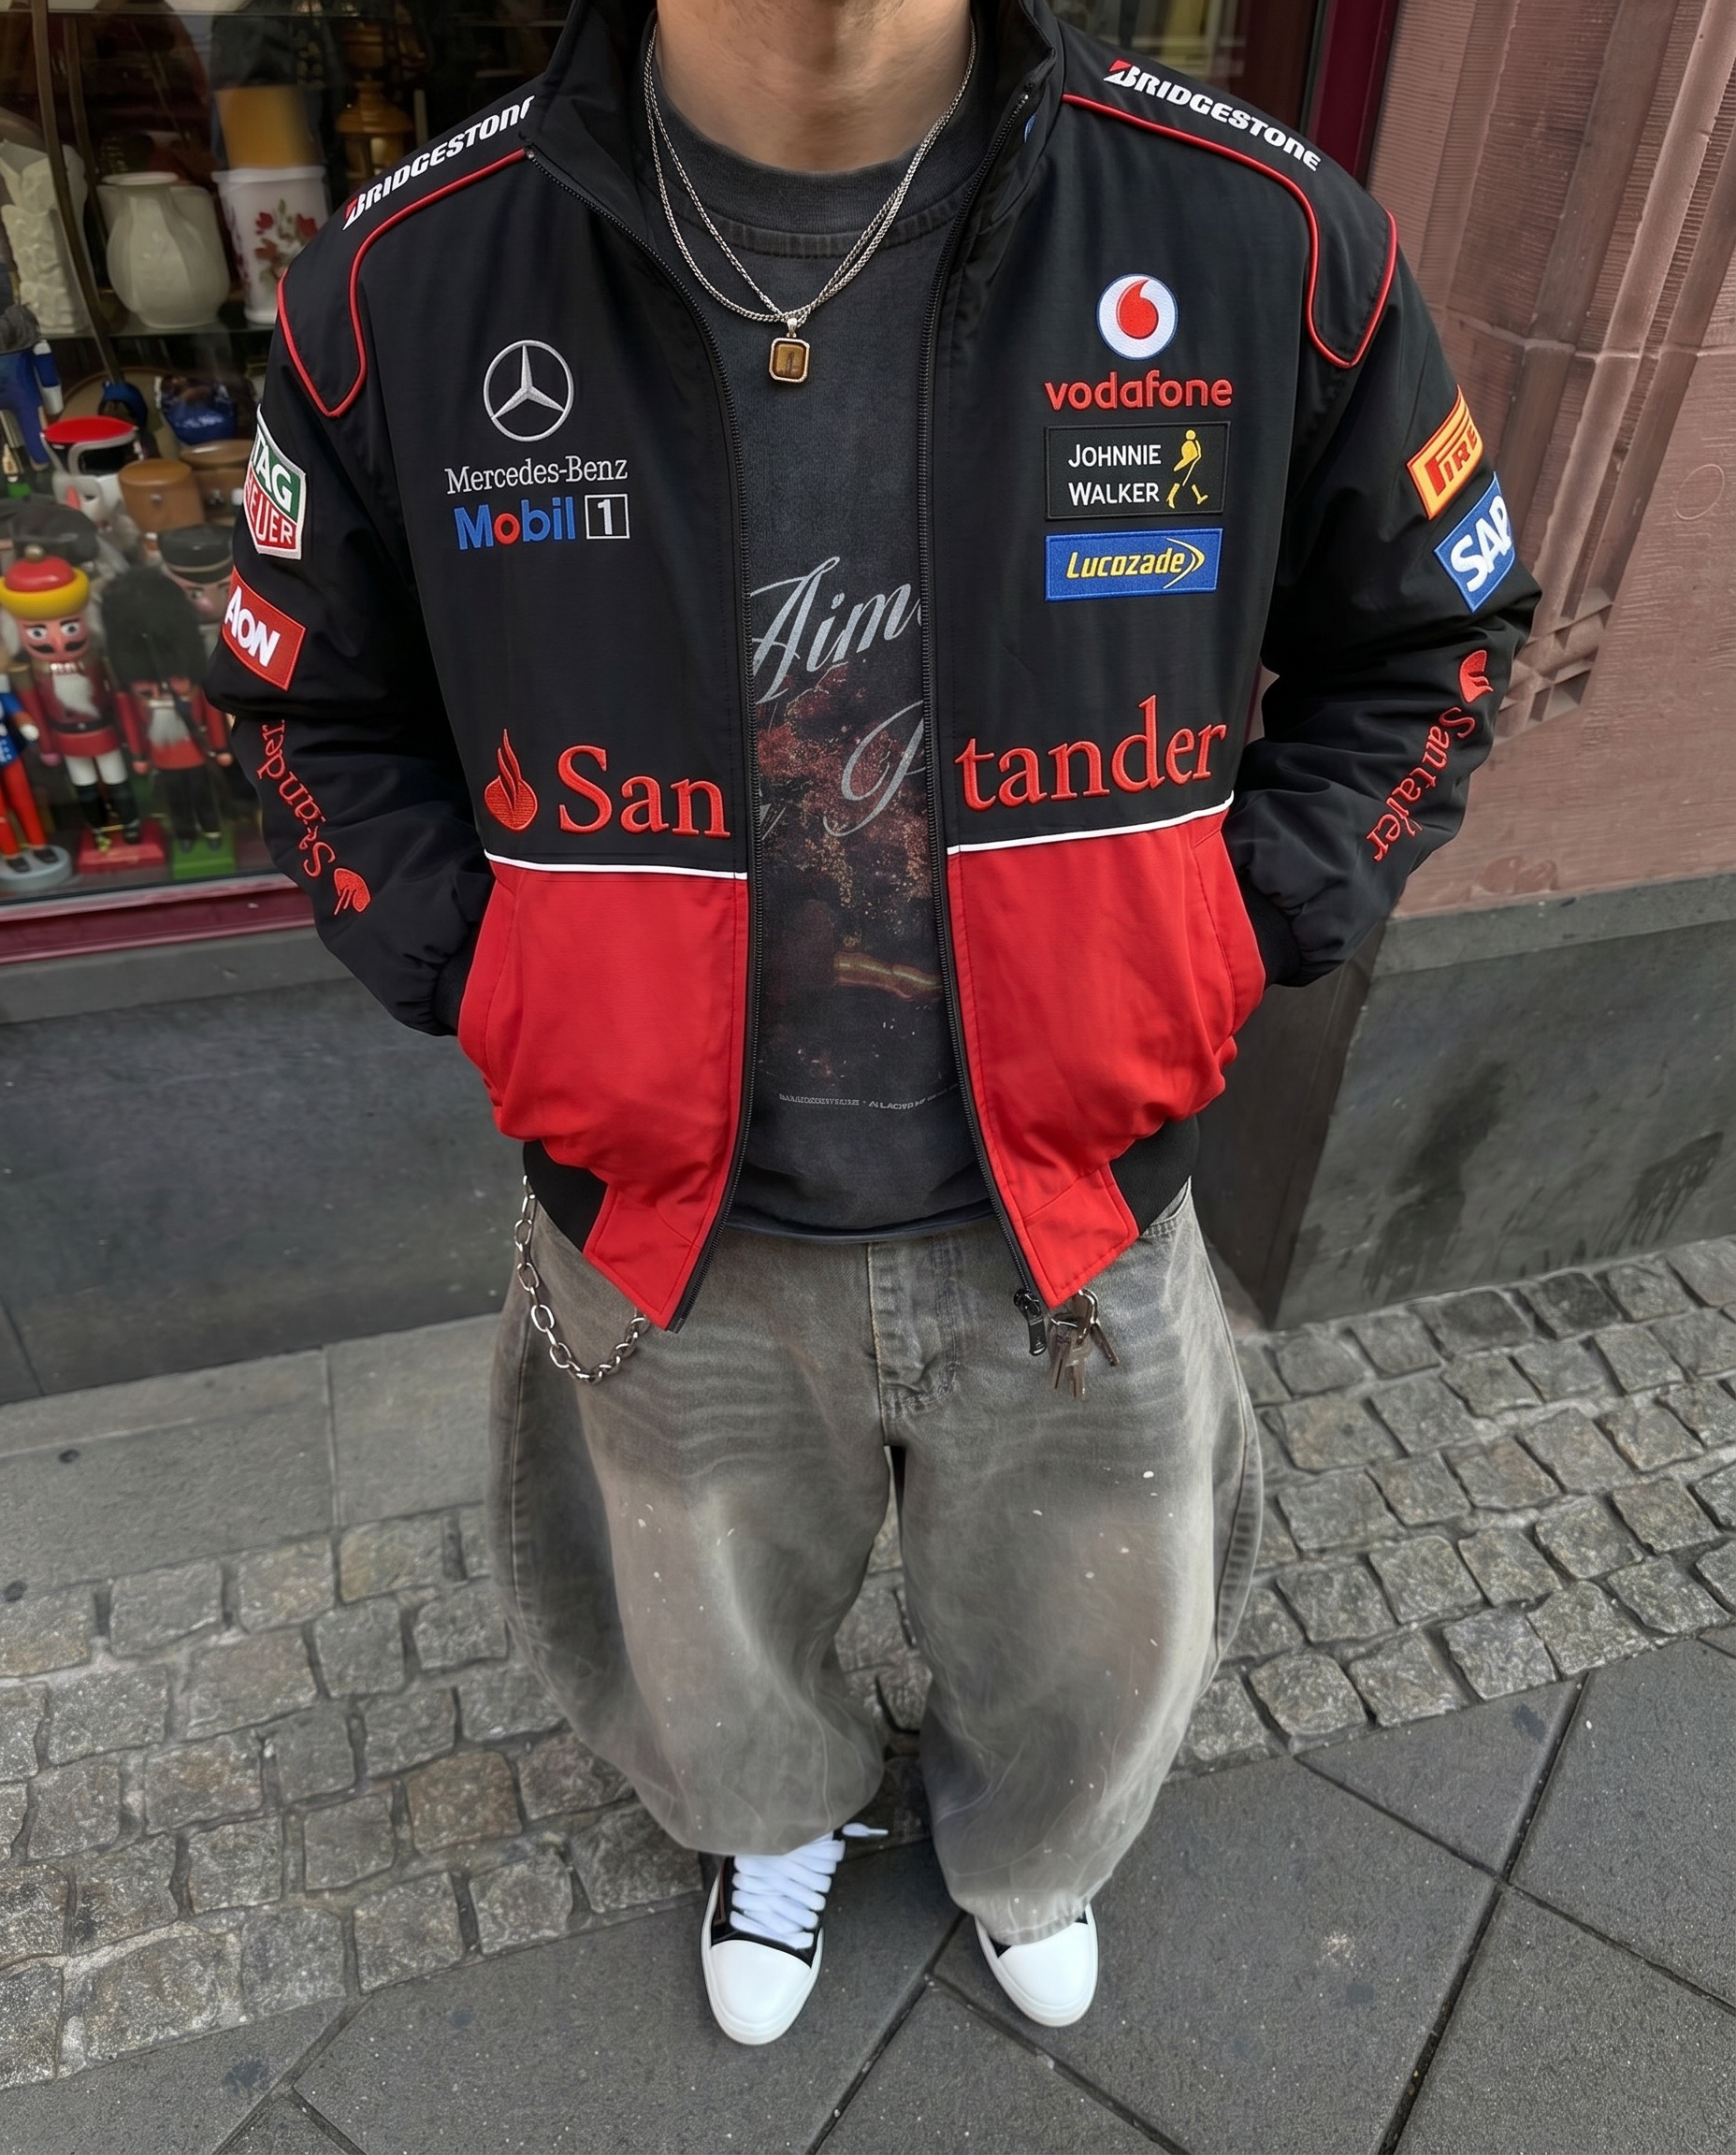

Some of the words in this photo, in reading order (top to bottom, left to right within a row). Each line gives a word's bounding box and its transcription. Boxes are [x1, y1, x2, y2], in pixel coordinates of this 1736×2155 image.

[1104, 59, 1321, 171] BRIDGESTONE
[1045, 370, 1233, 411] vodafone
[252, 424, 293, 513] TAG
[444, 455, 629, 494] Mercedes-Benz
[1068, 443, 1162, 468] JOHNNIE
[1068, 482, 1161, 506] WALKER
[454, 496, 576, 550] Mobil
[1451, 495, 1512, 592] SAP
[1066, 547, 1185, 579] Lucozade
[224, 586, 281, 667] AON
